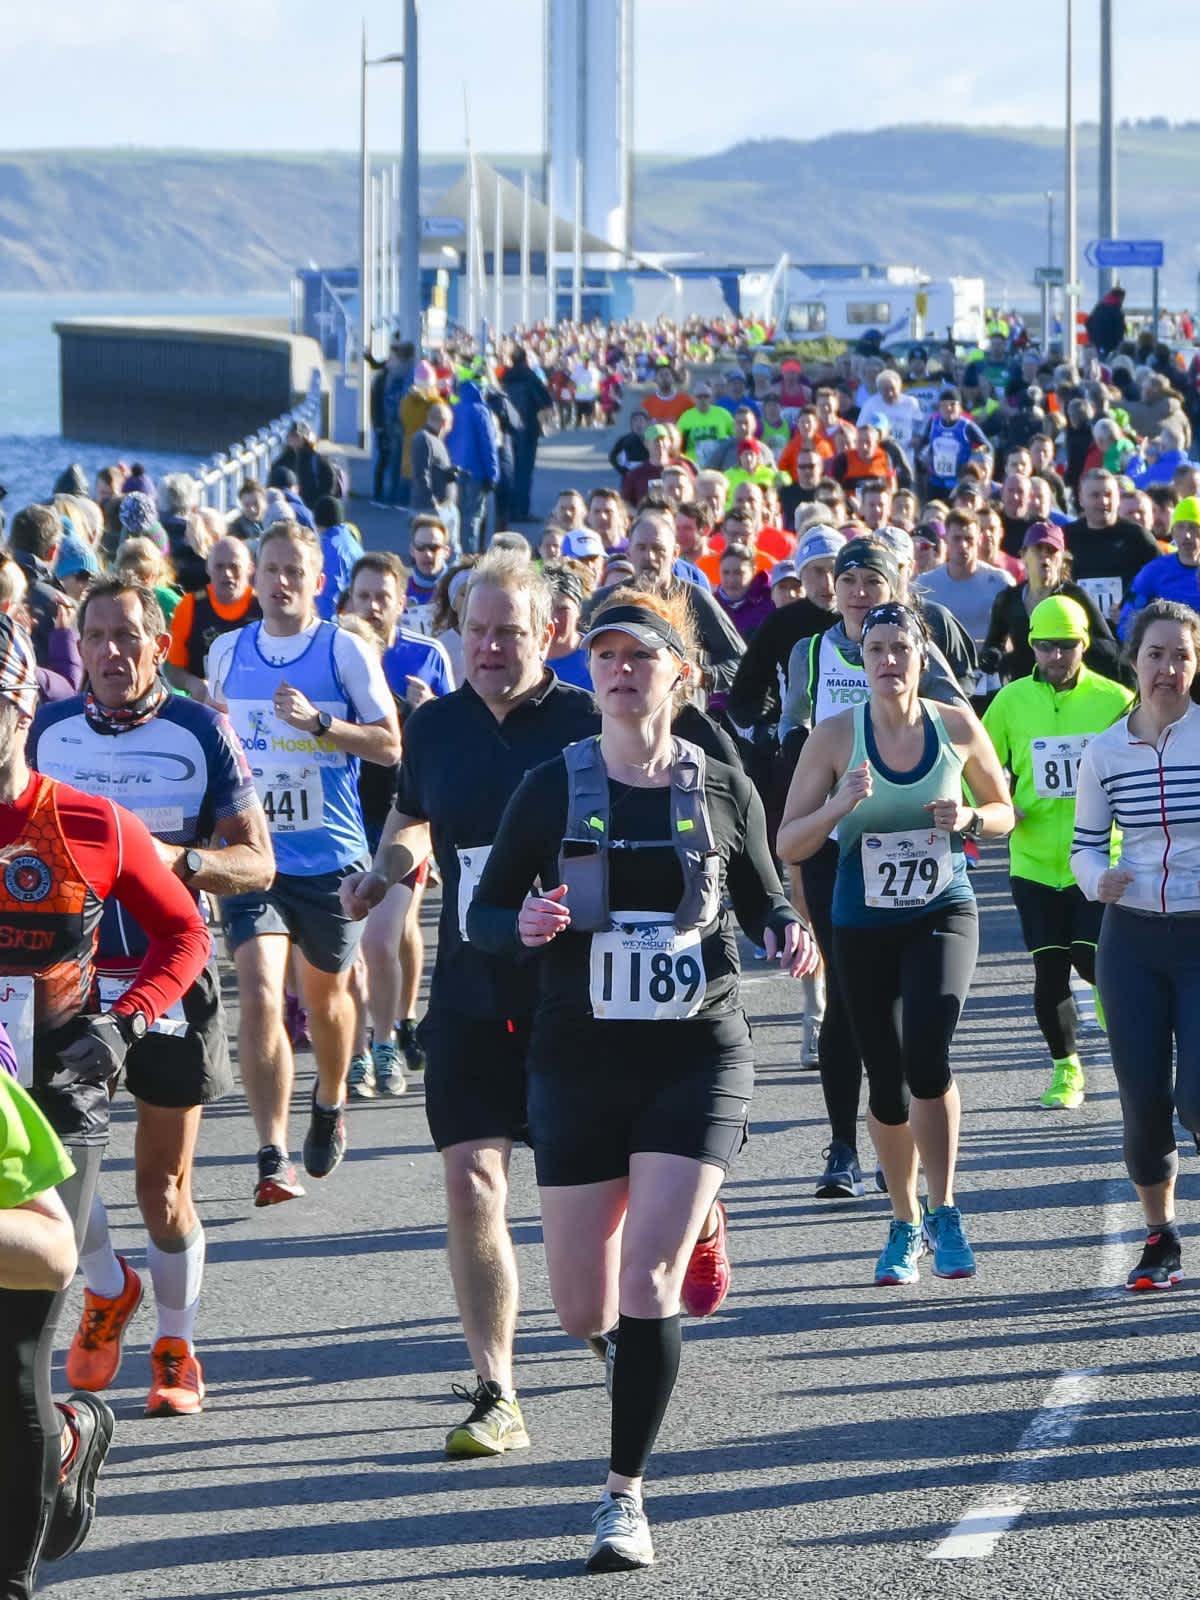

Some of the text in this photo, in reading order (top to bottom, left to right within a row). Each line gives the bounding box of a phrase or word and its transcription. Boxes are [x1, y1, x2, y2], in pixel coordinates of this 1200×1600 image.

[826, 679, 871, 688] MAGDAL
[262, 788, 309, 822] 441
[878, 857, 939, 897] 279
[893, 896, 926, 908] Rowena
[602, 951, 701, 1003] 1189
